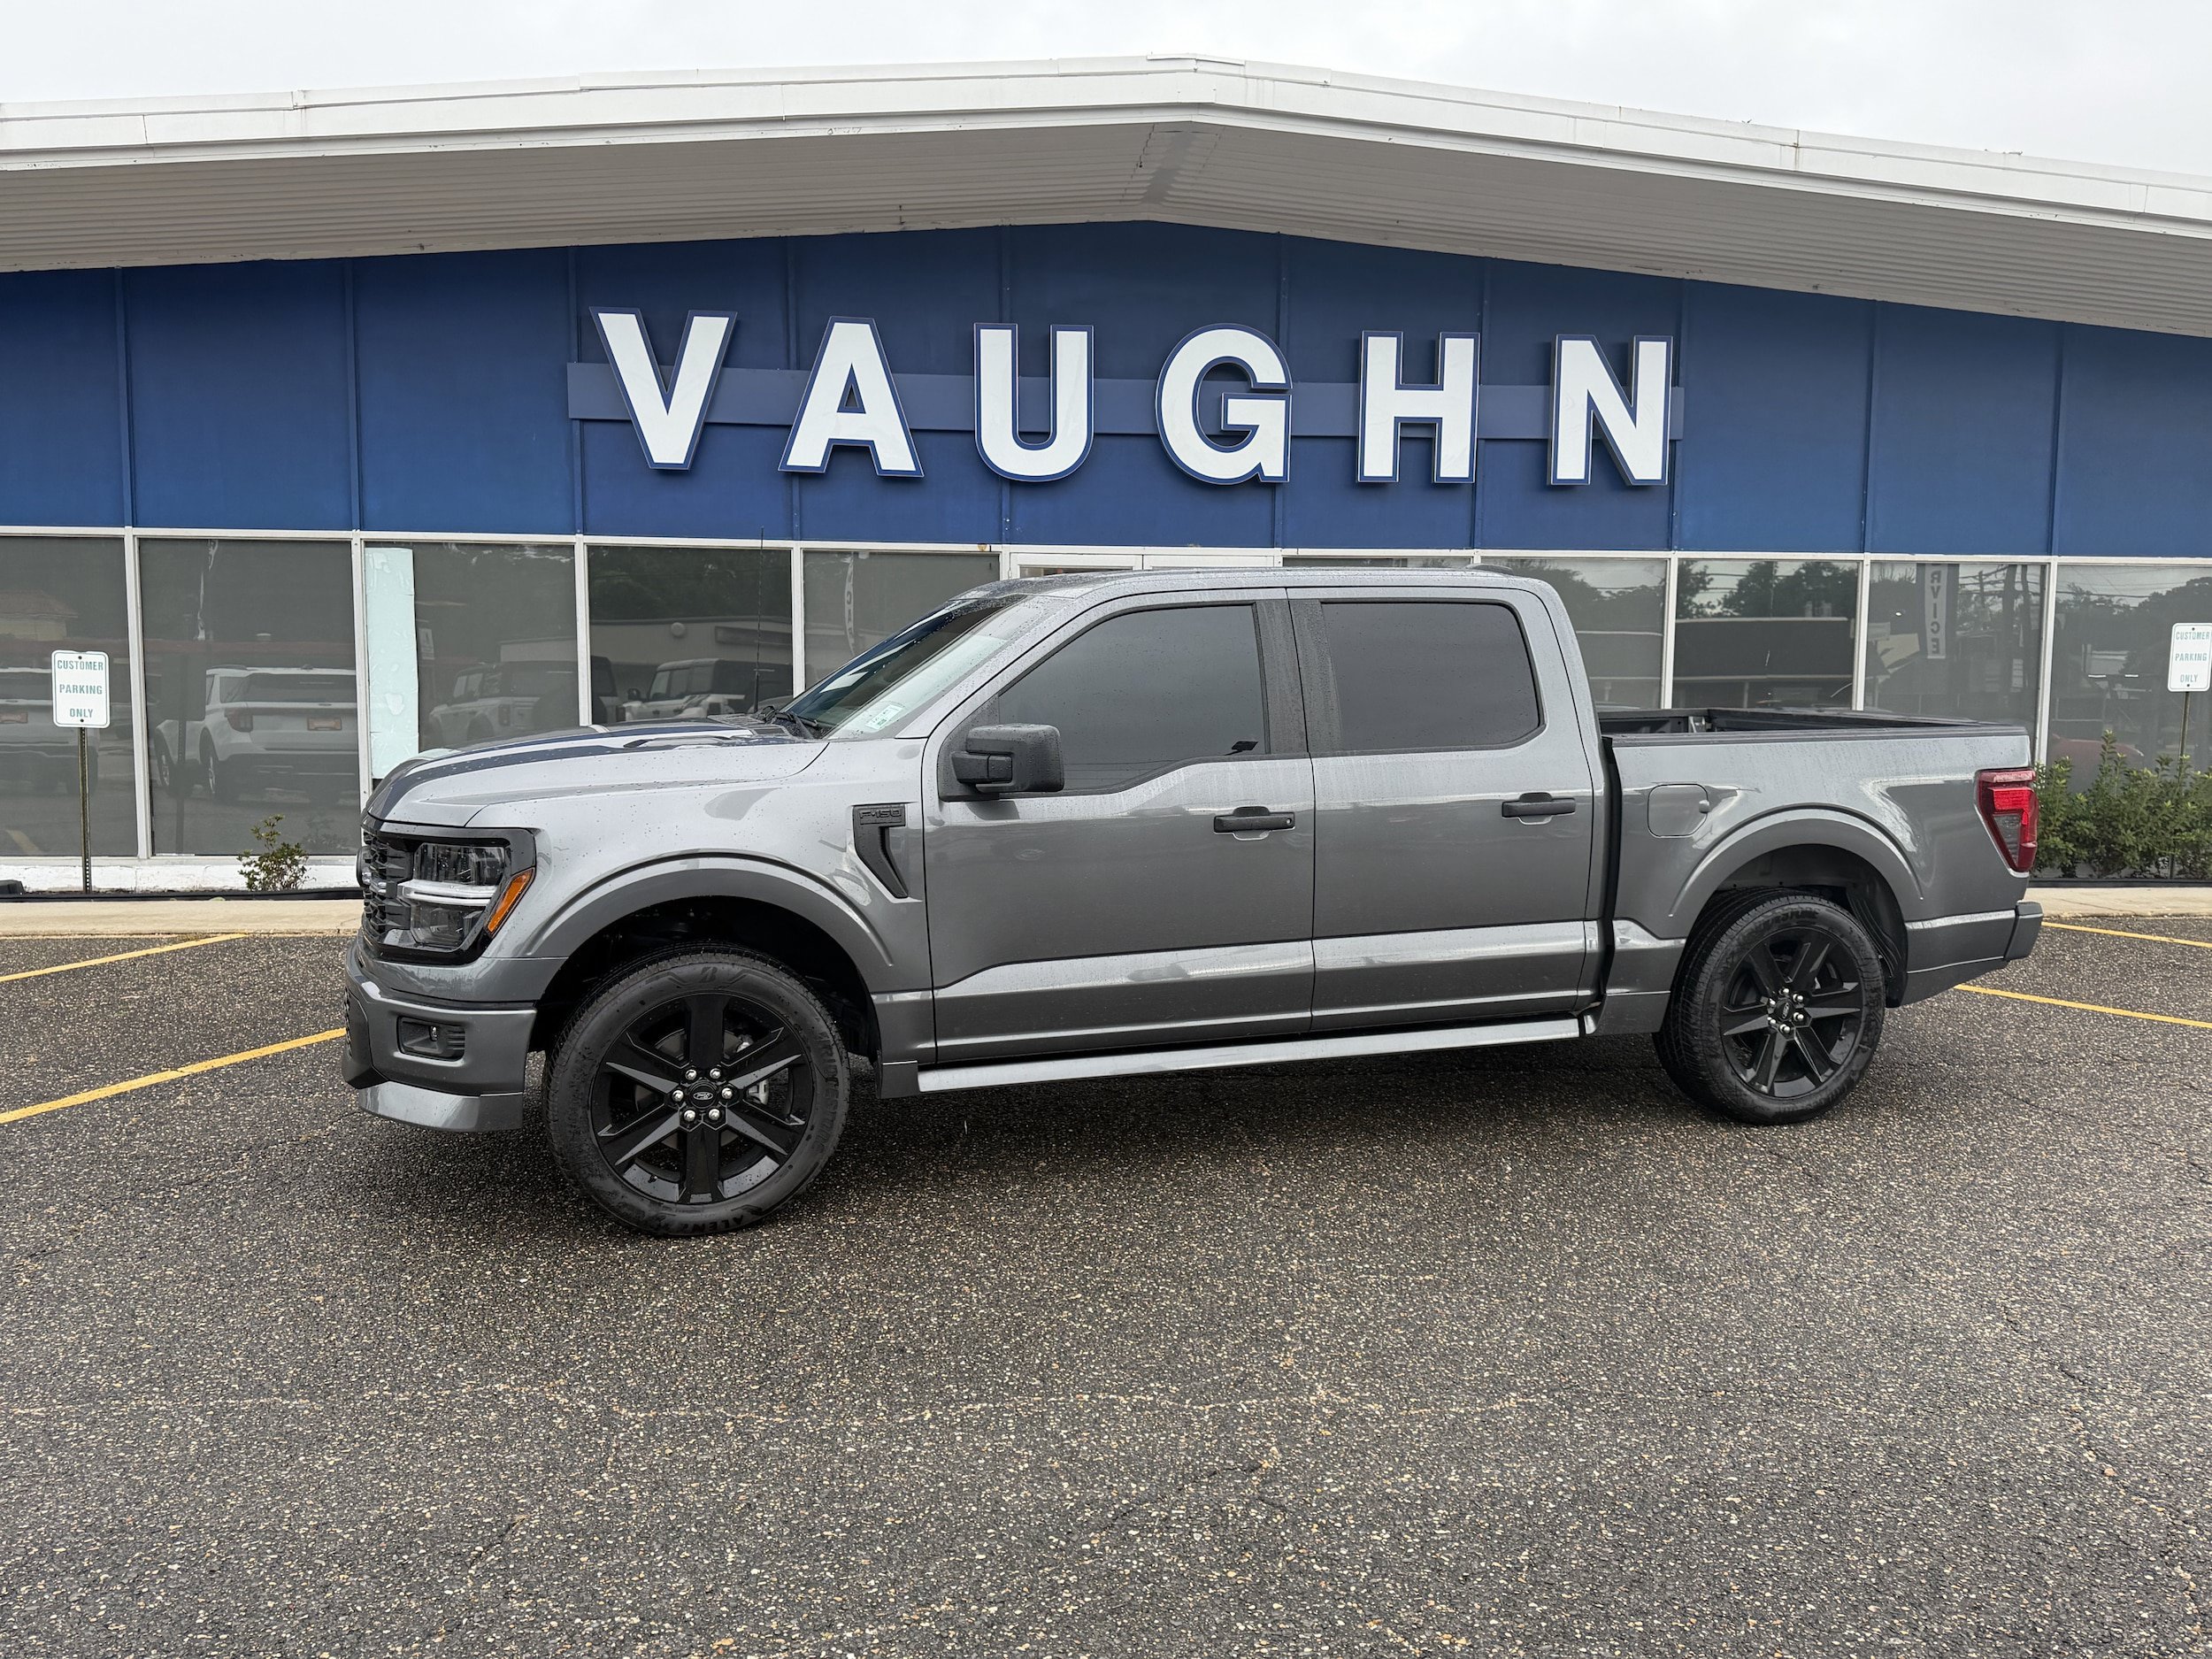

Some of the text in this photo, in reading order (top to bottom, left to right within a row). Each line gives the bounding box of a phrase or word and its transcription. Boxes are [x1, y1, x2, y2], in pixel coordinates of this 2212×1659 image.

[590, 306, 1672, 485] VAUGHN
[57, 660, 104, 671] CUSTOMER
[59, 684, 103, 695] PARKING
[70, 708, 94, 718] ONLY
